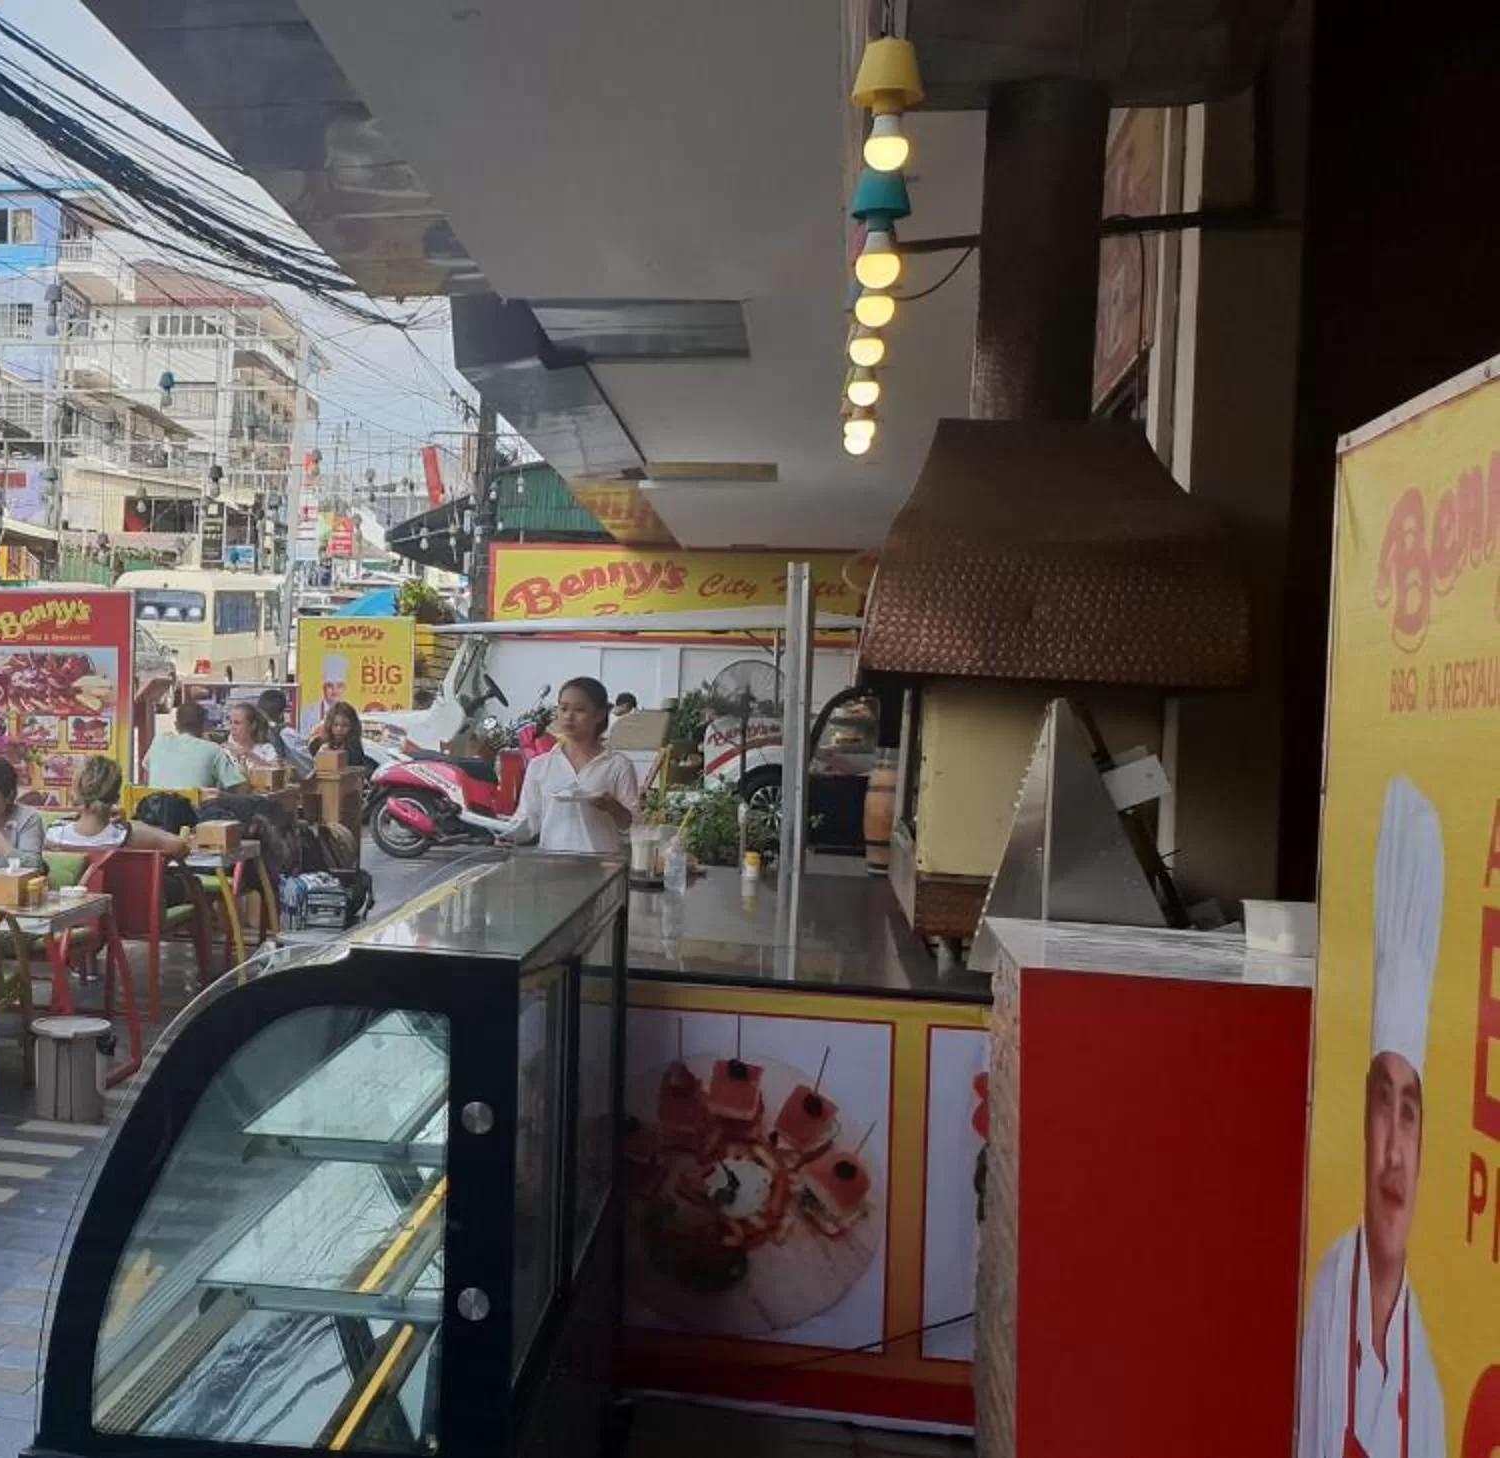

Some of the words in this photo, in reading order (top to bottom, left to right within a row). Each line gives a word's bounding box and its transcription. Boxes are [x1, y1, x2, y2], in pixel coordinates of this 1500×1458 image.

[501, 559, 689, 620] Benny's
[698, 574, 758, 600] City
[318, 624, 385, 641] Benny's
[361, 665, 403, 685] BIG
